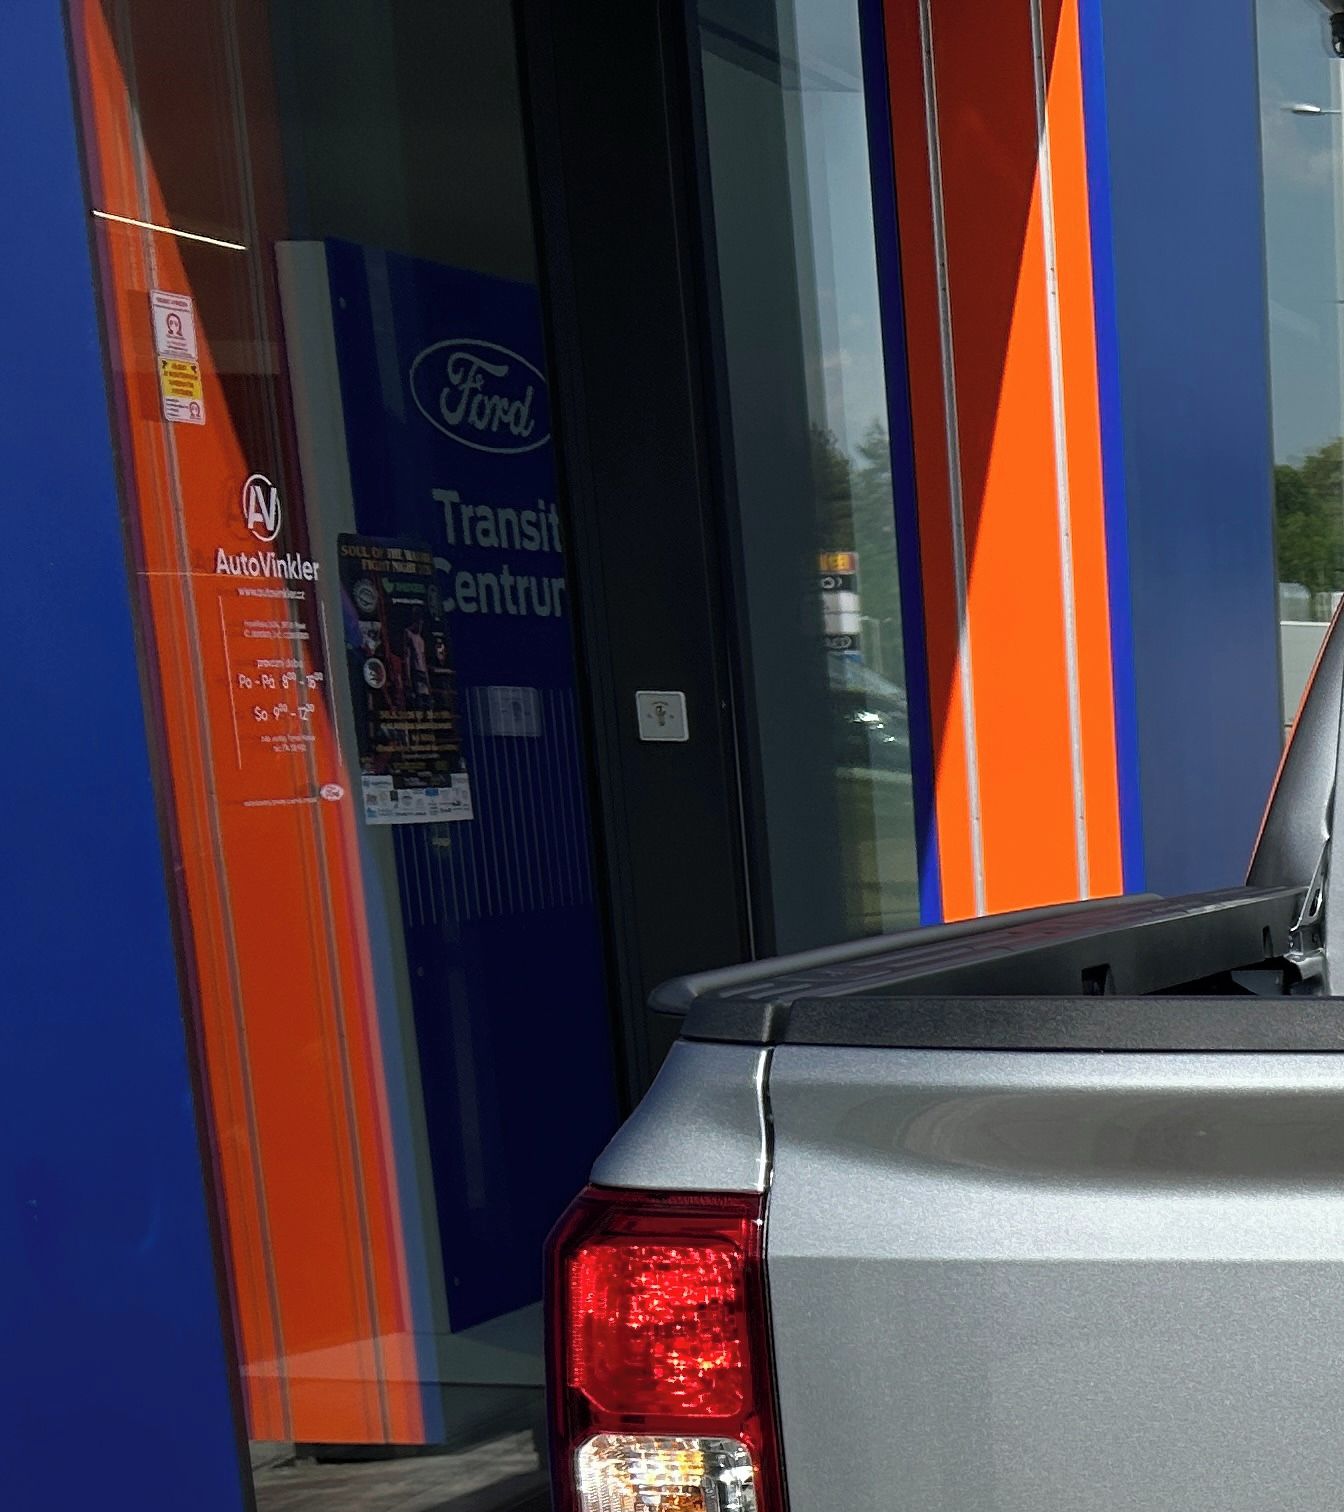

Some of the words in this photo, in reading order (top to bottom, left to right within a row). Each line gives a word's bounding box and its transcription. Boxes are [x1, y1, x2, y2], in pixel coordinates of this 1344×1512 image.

[440, 352, 536, 437] Ford
[432, 487, 563, 552] Transit
[216, 547, 320, 581] AutoVinkler
